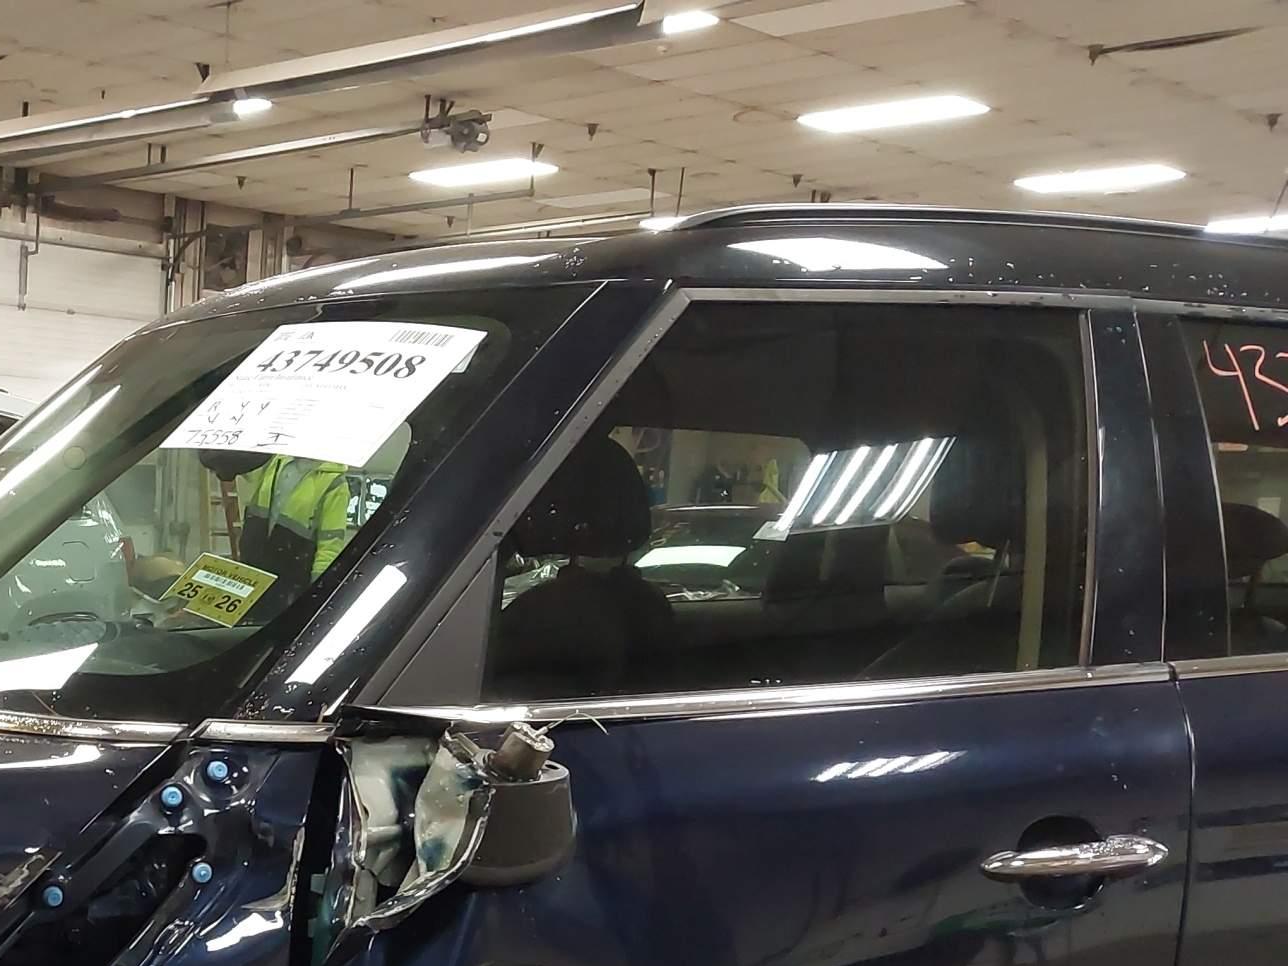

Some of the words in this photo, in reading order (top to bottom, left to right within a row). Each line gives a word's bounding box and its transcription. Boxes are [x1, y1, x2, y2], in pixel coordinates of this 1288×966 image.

[257, 350, 426, 379] 43749508
[1203, 337, 1288, 431] 43
[177, 582, 203, 599] 25
[214, 595, 242, 613] 26
